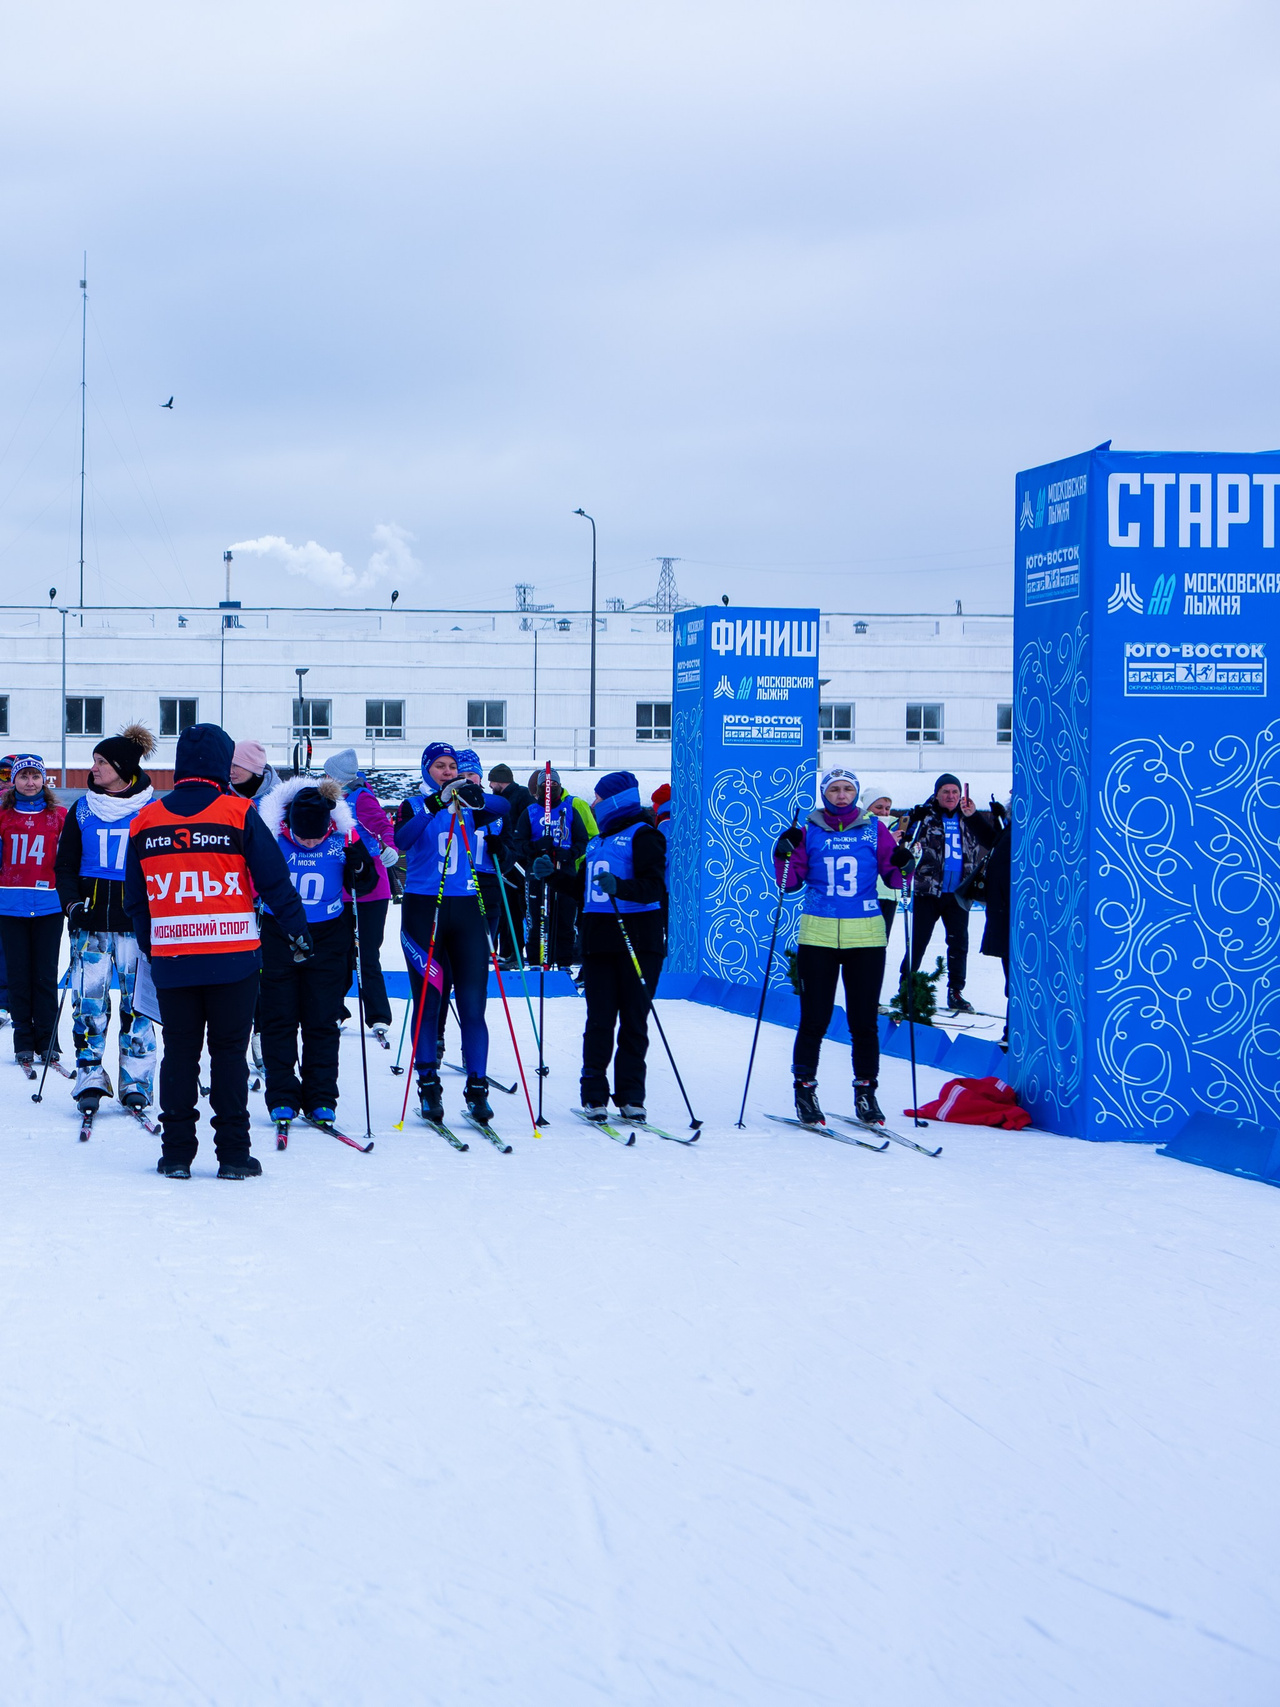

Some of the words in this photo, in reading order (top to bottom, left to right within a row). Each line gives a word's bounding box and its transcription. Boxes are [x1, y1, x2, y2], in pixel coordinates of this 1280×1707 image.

[1107, 473, 1280, 548] СТАРТ
[1025, 546, 1080, 570] ЮГО-ВОСТОК
[1183, 595, 1241, 615] ЛЫЖНЯ
[711, 619, 817, 657] ФИНИШ
[1124, 642, 1267, 658] ЮГО-ВОСТОК
[756, 676, 814, 689] МОСКОВСКАЯ
[756, 689, 789, 701] ЛЫЖНЯ
[723, 715, 803, 725] ЮГО-ВОСТОК
[10, 834, 46, 866] 114
[96, 828, 129, 870] 17
[145, 836, 171, 849] Arta
[192, 832, 231, 847] Sport
[437, 831, 459, 875] 9
[145, 871, 243, 904] СУДЬЯ
[781, 859, 790, 894] NORDWAY
[823, 855, 858, 897] 13
[154, 920, 217, 938] МОСКОВСКИЙ
[220, 921, 249, 935] СПОРТ
